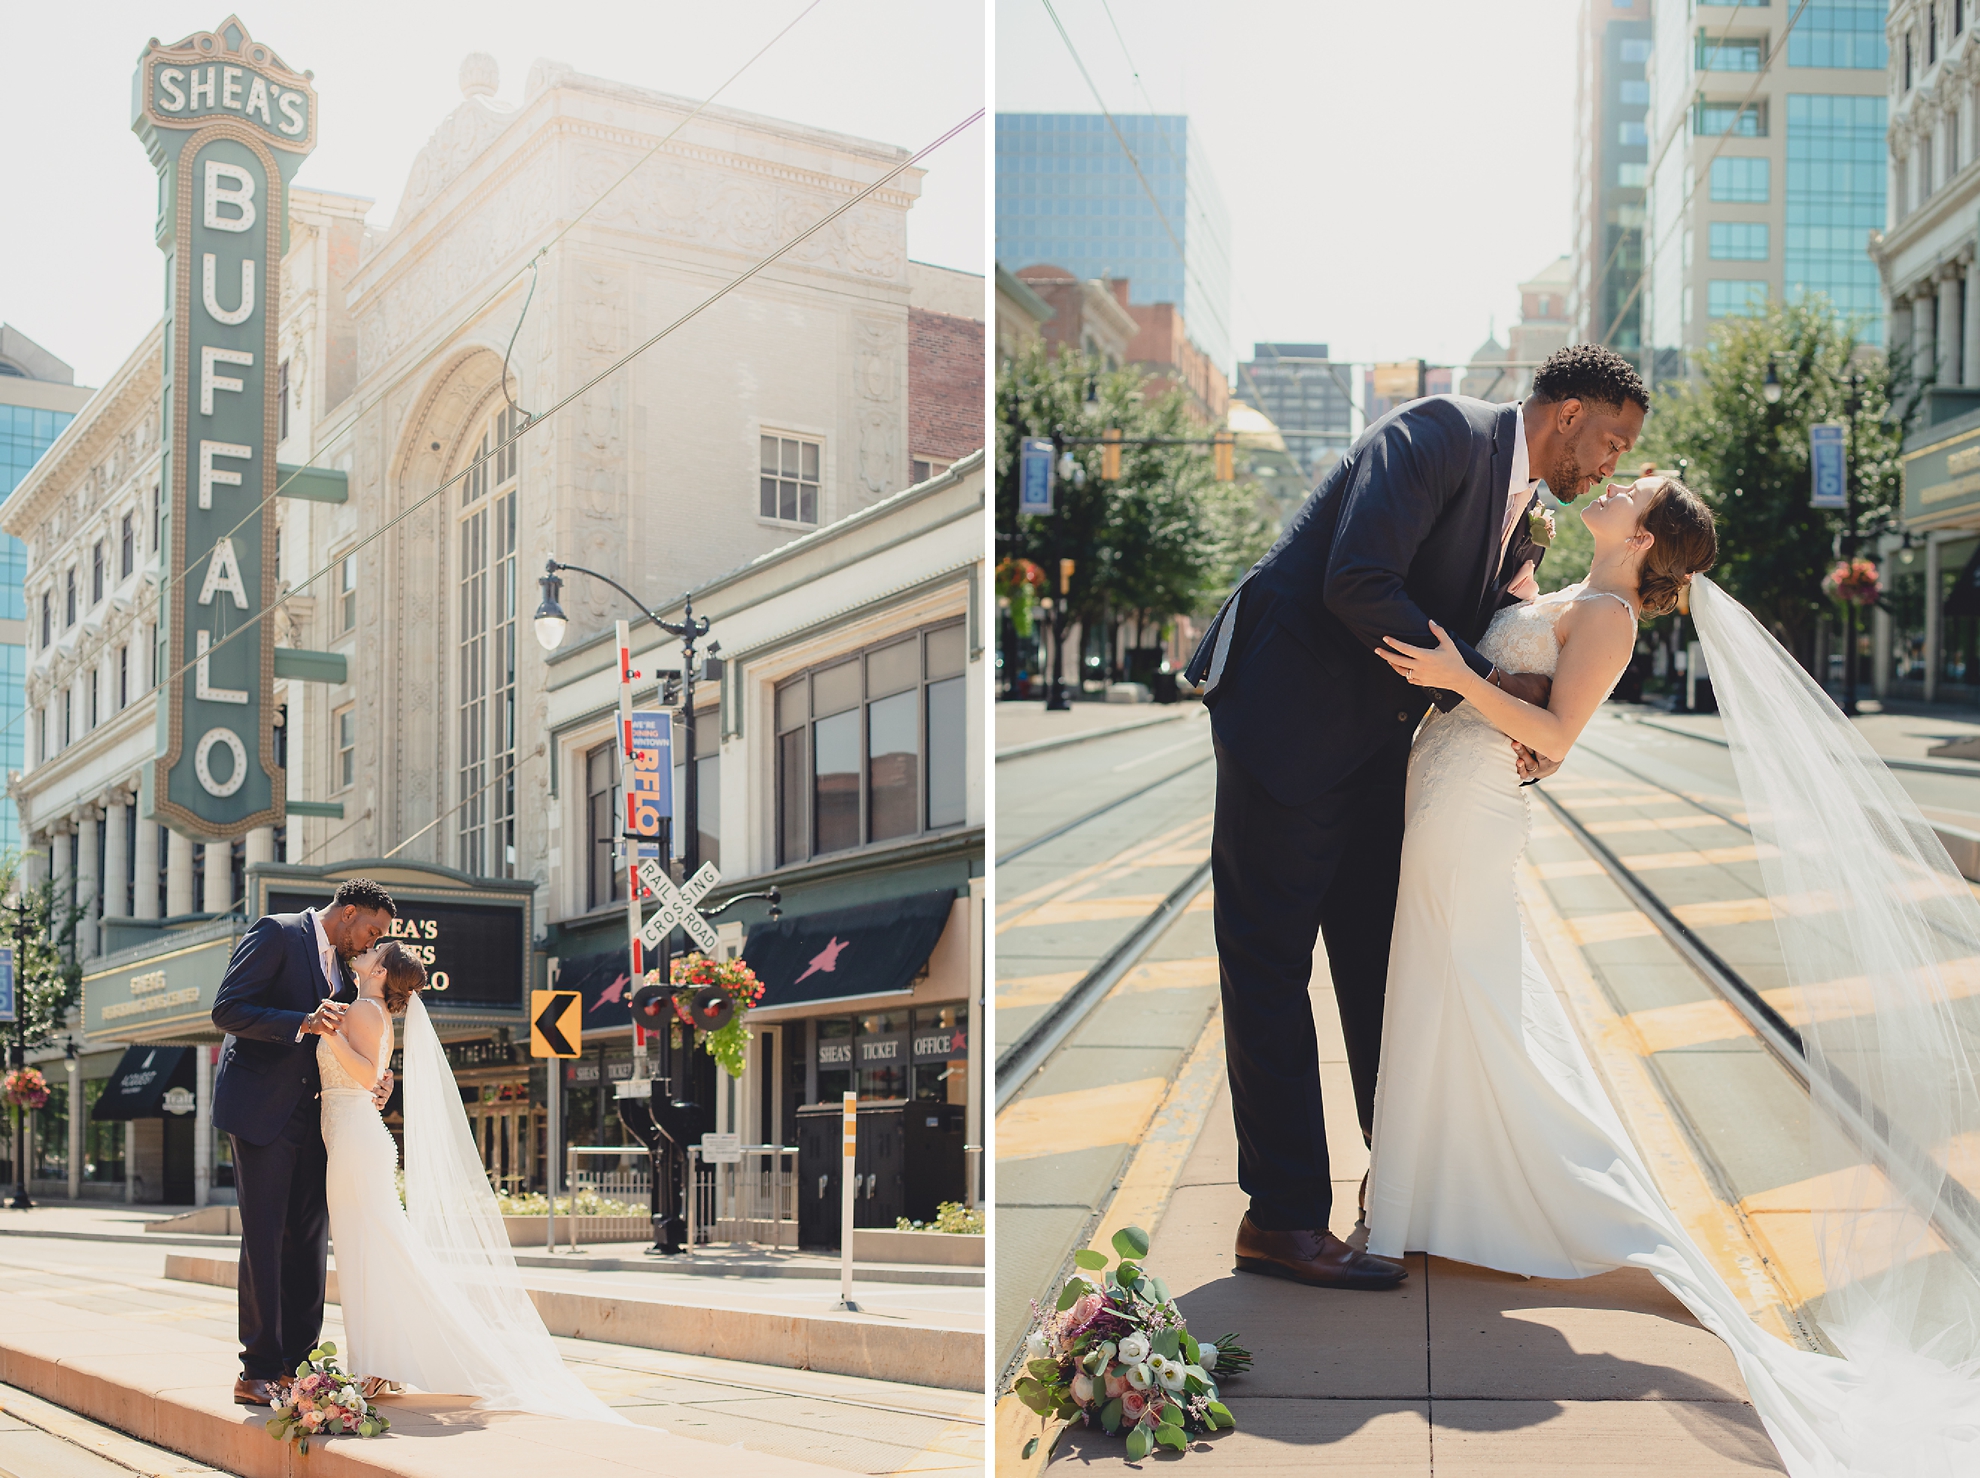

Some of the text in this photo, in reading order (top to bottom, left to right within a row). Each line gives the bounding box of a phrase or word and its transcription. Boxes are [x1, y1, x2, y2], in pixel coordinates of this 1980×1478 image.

[159, 65, 304, 135] SHEA'S
[194, 160, 257, 798] BUFFALO
[633, 738, 670, 747] WNTOWN
[634, 748, 660, 837] BFLO
[385, 918, 438, 939] EA'S
[642, 864, 671, 900] RAIL
[684, 912, 715, 948] ROAD
[645, 870, 715, 941] CROSSING
[819, 1035, 951, 1063] SHEA'S TICKET OFFICE
